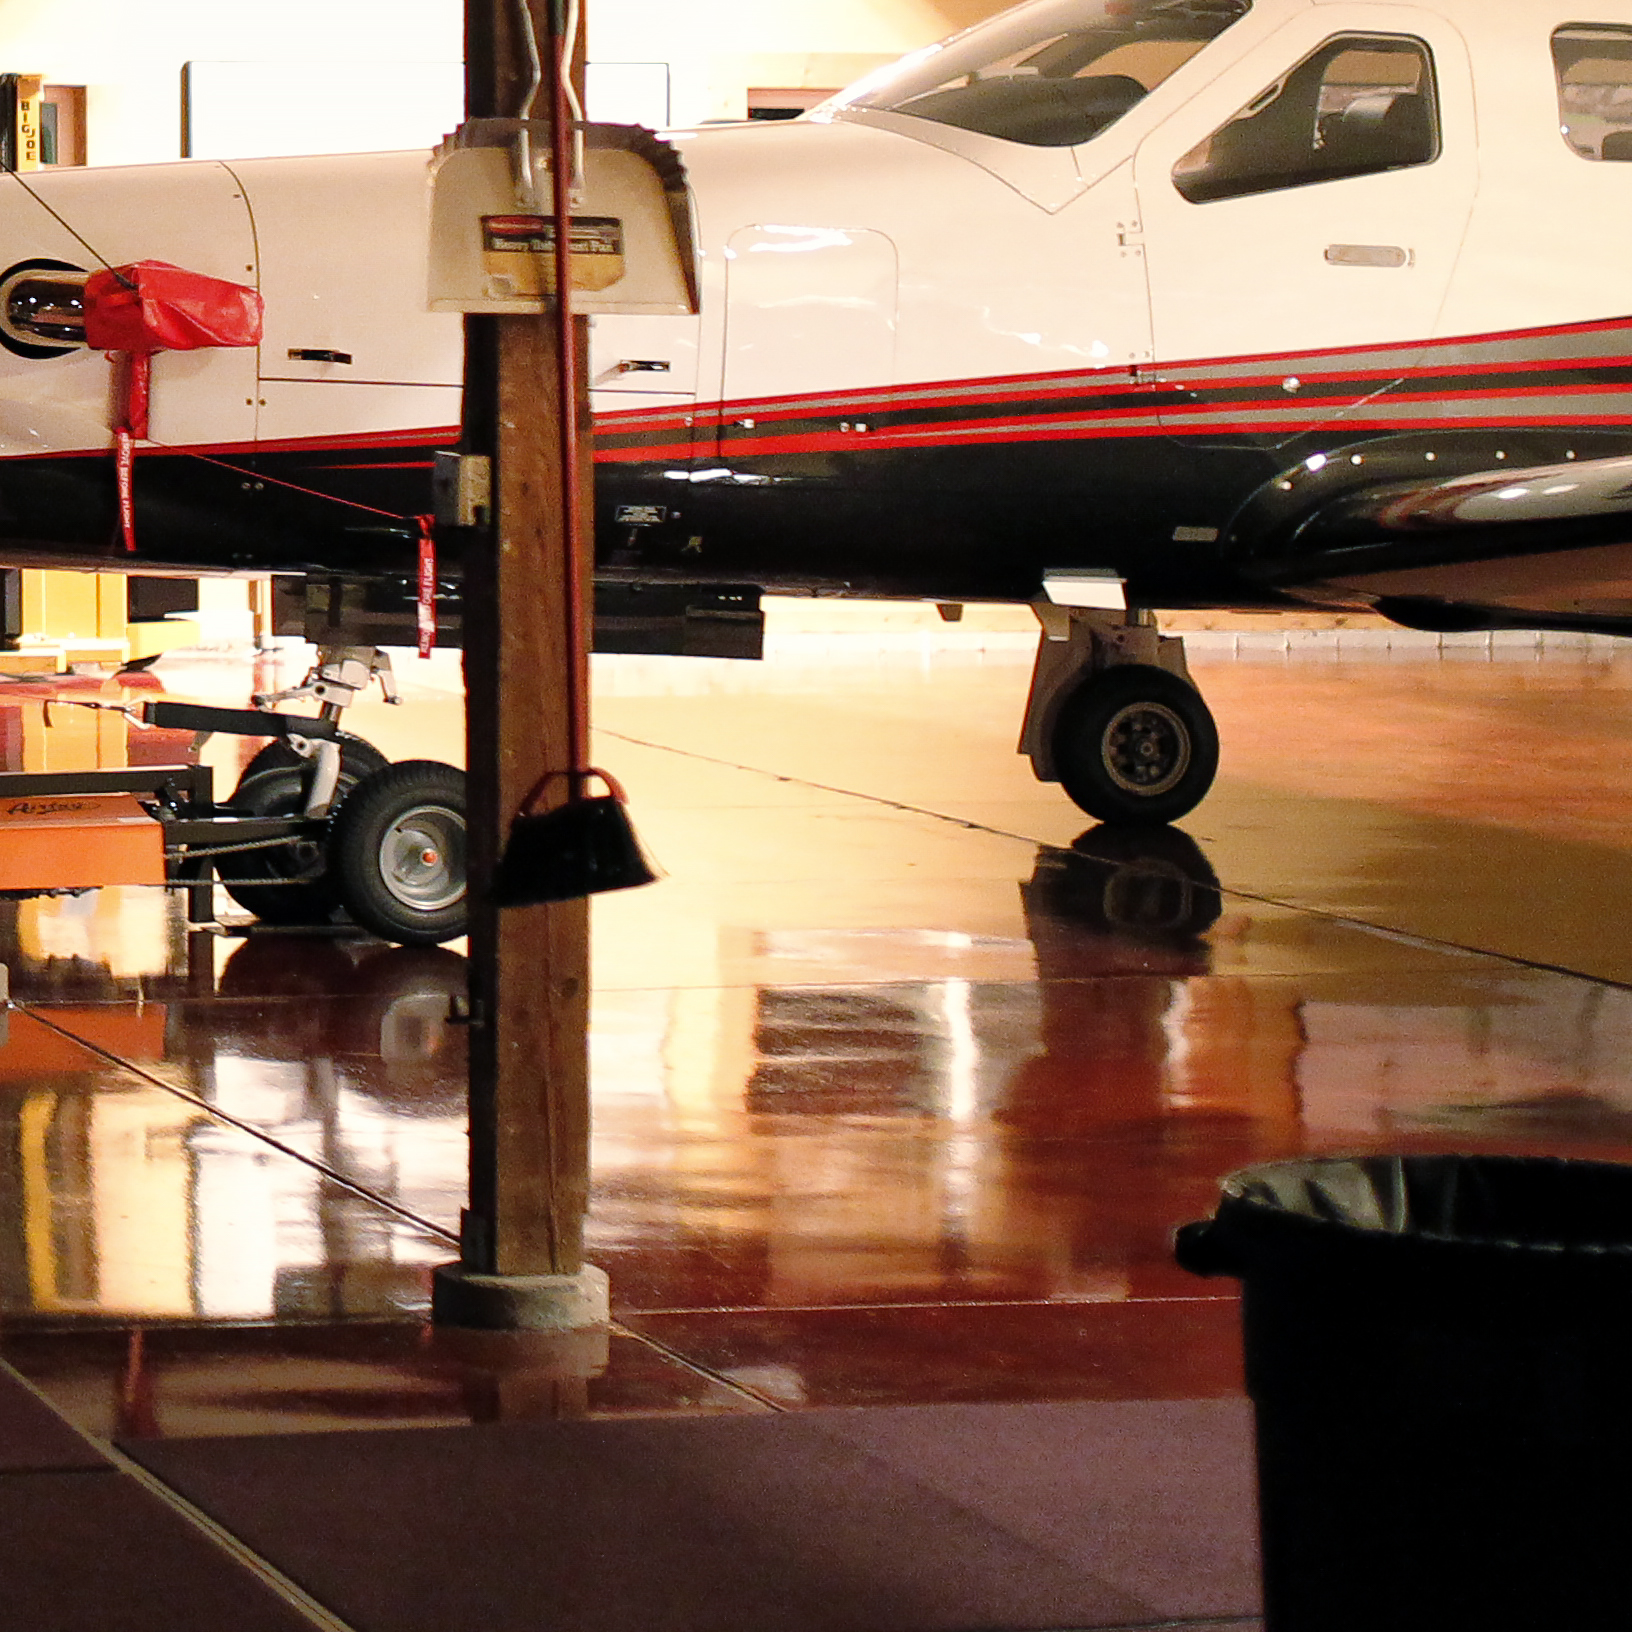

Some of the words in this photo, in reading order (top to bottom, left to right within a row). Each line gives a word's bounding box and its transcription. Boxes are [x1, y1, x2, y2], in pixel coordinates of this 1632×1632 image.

[21, 100, 31, 134] BIG
[26, 128, 36, 161] JOE
[120, 432, 131, 466] REMOVE
[119, 466, 129, 499] BEFORE
[122, 499, 131, 529] FLIGHT
